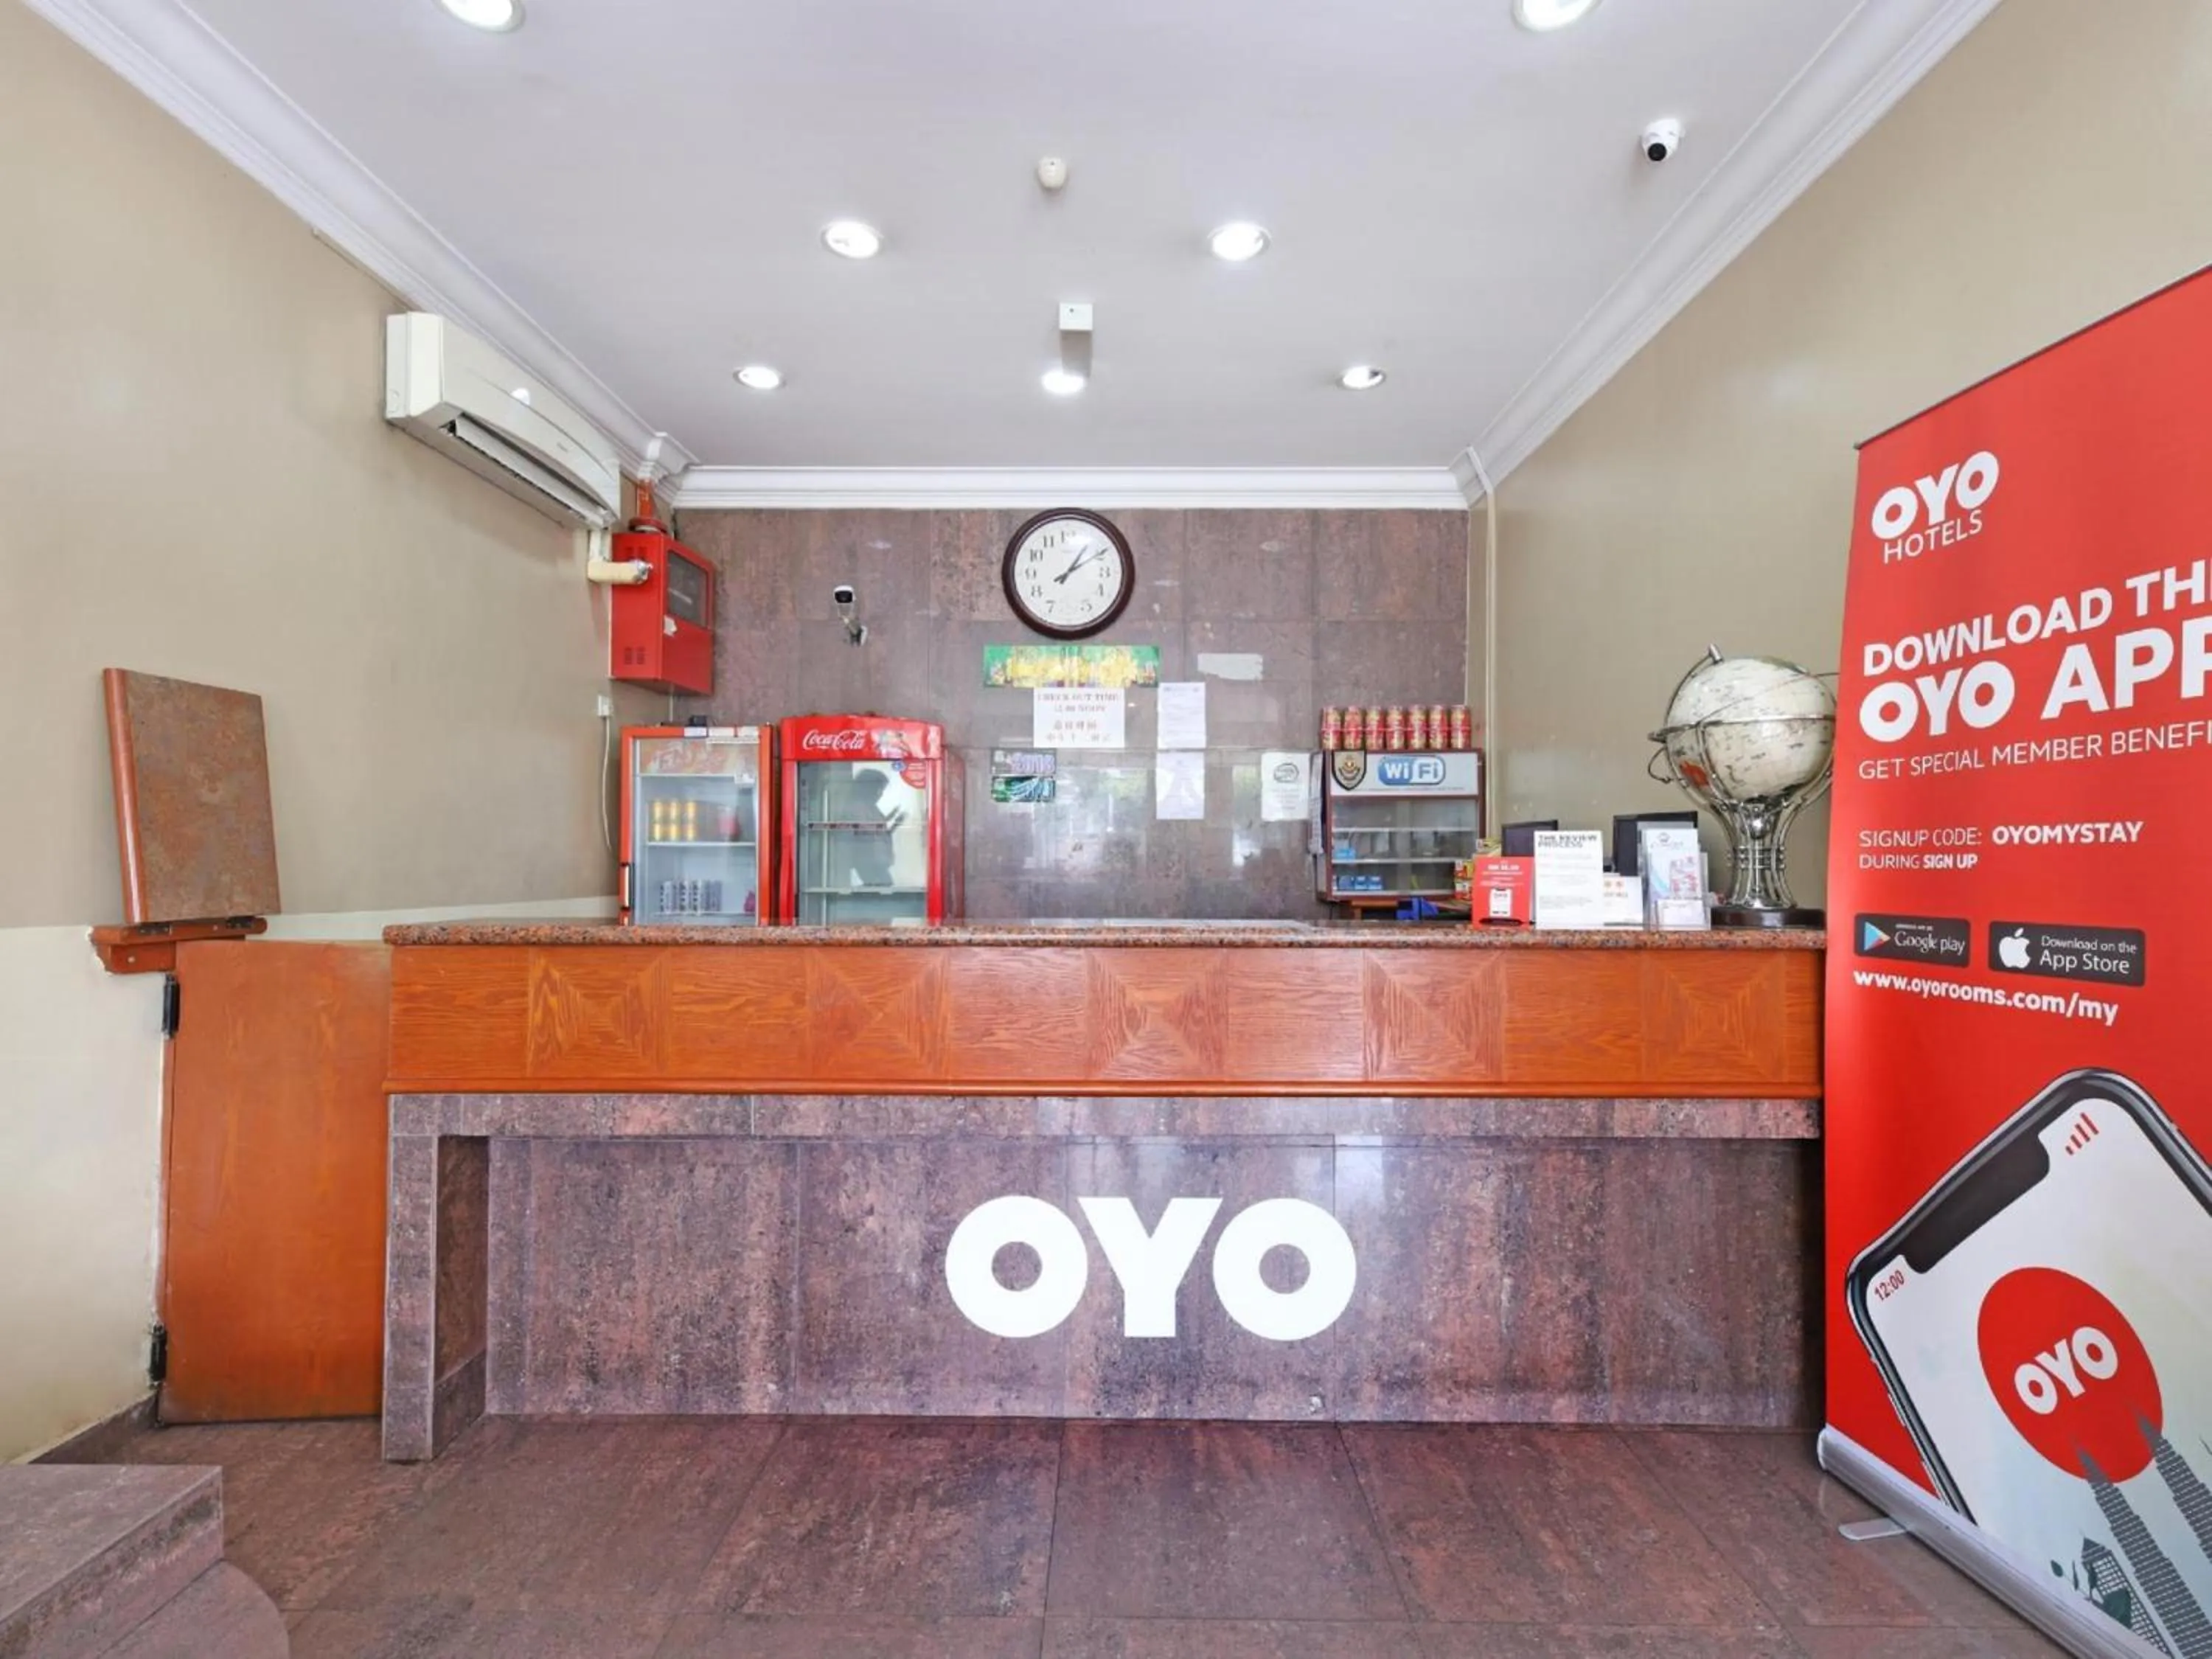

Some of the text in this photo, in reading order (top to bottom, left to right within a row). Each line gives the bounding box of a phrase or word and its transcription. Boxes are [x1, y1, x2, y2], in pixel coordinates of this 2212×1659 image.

[1871, 451, 2000, 540] OYO
[1883, 509, 1983, 564] HOTELS
[1046, 600, 1055, 613] 7
[1863, 558, 2212, 677] DOWNLOAD TH
[1859, 615, 2212, 742] OYO APP
[1858, 758, 1905, 779] GET
[1910, 749, 1985, 776] SPECIAL
[1992, 734, 2102, 765] MEMBER
[1859, 821, 2143, 848] SIGNUP CODE: OYOMYSTAY
[1859, 853, 1978, 869] DURING SIGN UP
[1893, 931, 1966, 956] Google play
[2039, 948, 2130, 974] App Store
[2040, 935, 2137, 954] Download on the
[1852, 970, 2118, 1026] www.oyorooms.com/my
[945, 1194, 1357, 1340] OYO
[1874, 1269, 1905, 1301] 12:00
[2014, 1326, 2118, 1416] OYO
